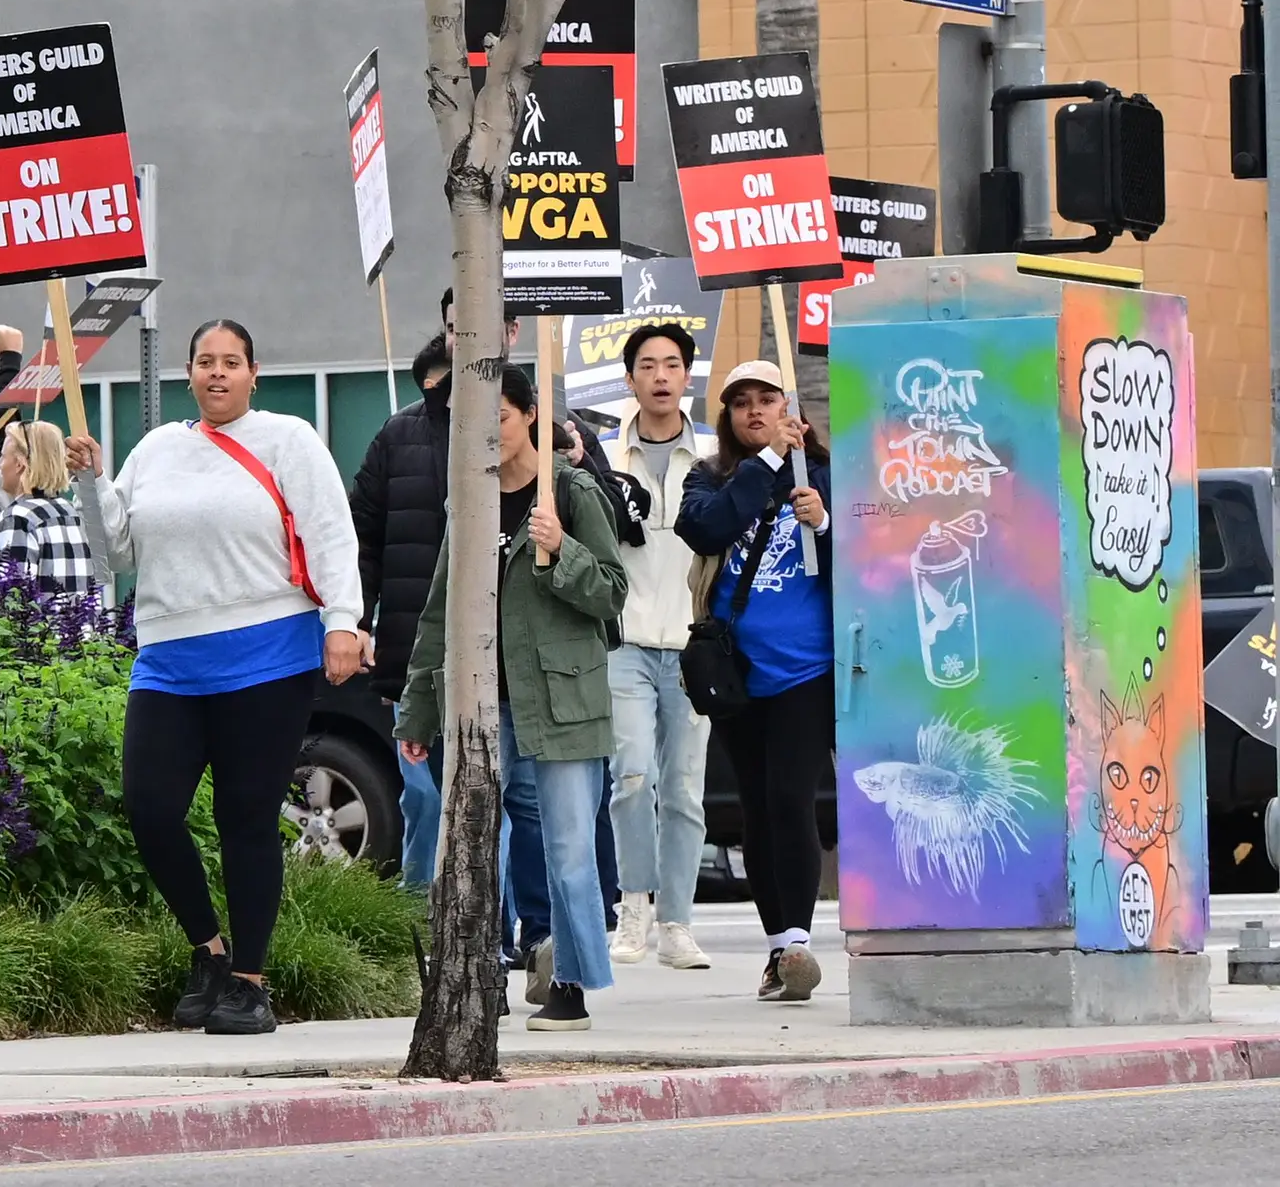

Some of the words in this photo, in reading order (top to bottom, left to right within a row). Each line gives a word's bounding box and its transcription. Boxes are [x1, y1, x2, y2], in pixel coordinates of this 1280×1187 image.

[547, 23, 593, 43] RICA
[39, 43, 104, 72] GUILD
[13, 83, 36, 103] OF
[673, 79, 754, 106] WRITERS
[755, 76, 803, 99] GUILD
[735, 107, 754, 124] OF
[710, 128, 788, 155] AMERICA
[20, 158, 60, 188] ON
[742, 173, 775, 200] ON
[830, 195, 881, 215] RITERS
[882, 200, 927, 221] GUILD
[694, 199, 828, 252] STRIKE!
[860, 219, 878, 234] OF
[502, 261, 535, 270] ogether
[558, 260, 581, 268] Better
[584, 260, 610, 268] Future
[1092, 411, 1164, 458] DOWN
[1104, 463, 1134, 495] take
[1136, 464, 1148, 496] it
[1100, 505, 1153, 572] Easy
[1122, 873, 1148, 903] GET
